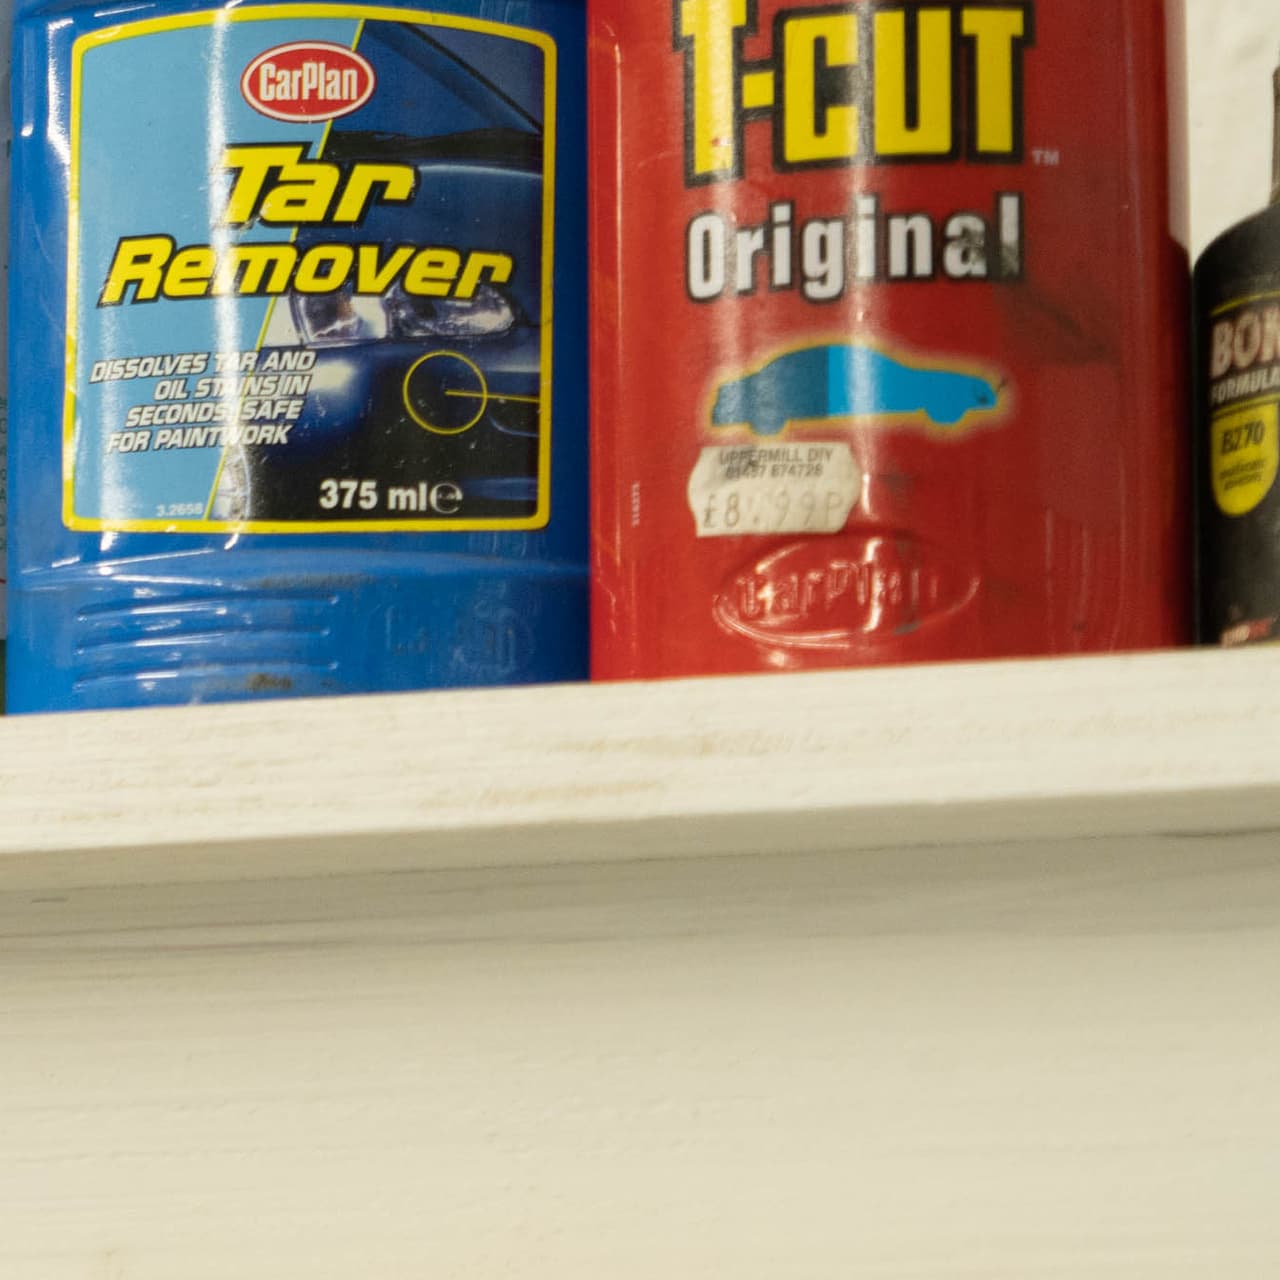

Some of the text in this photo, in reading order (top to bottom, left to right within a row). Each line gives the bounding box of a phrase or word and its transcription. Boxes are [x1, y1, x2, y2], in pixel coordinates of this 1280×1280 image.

[258, 62, 358, 101] CarPlan
[221, 142, 418, 228] Tar
[685, 192, 1024, 304] Original
[99, 234, 515, 307] Remover
[89, 352, 210, 384] DISSOLVES
[261, 350, 317, 371] AND
[153, 378, 189, 401] OIL
[281, 373, 312, 395] IN
[239, 399, 305, 421] SAFE
[106, 429, 151, 455] FOR
[319, 478, 378, 510] 375
